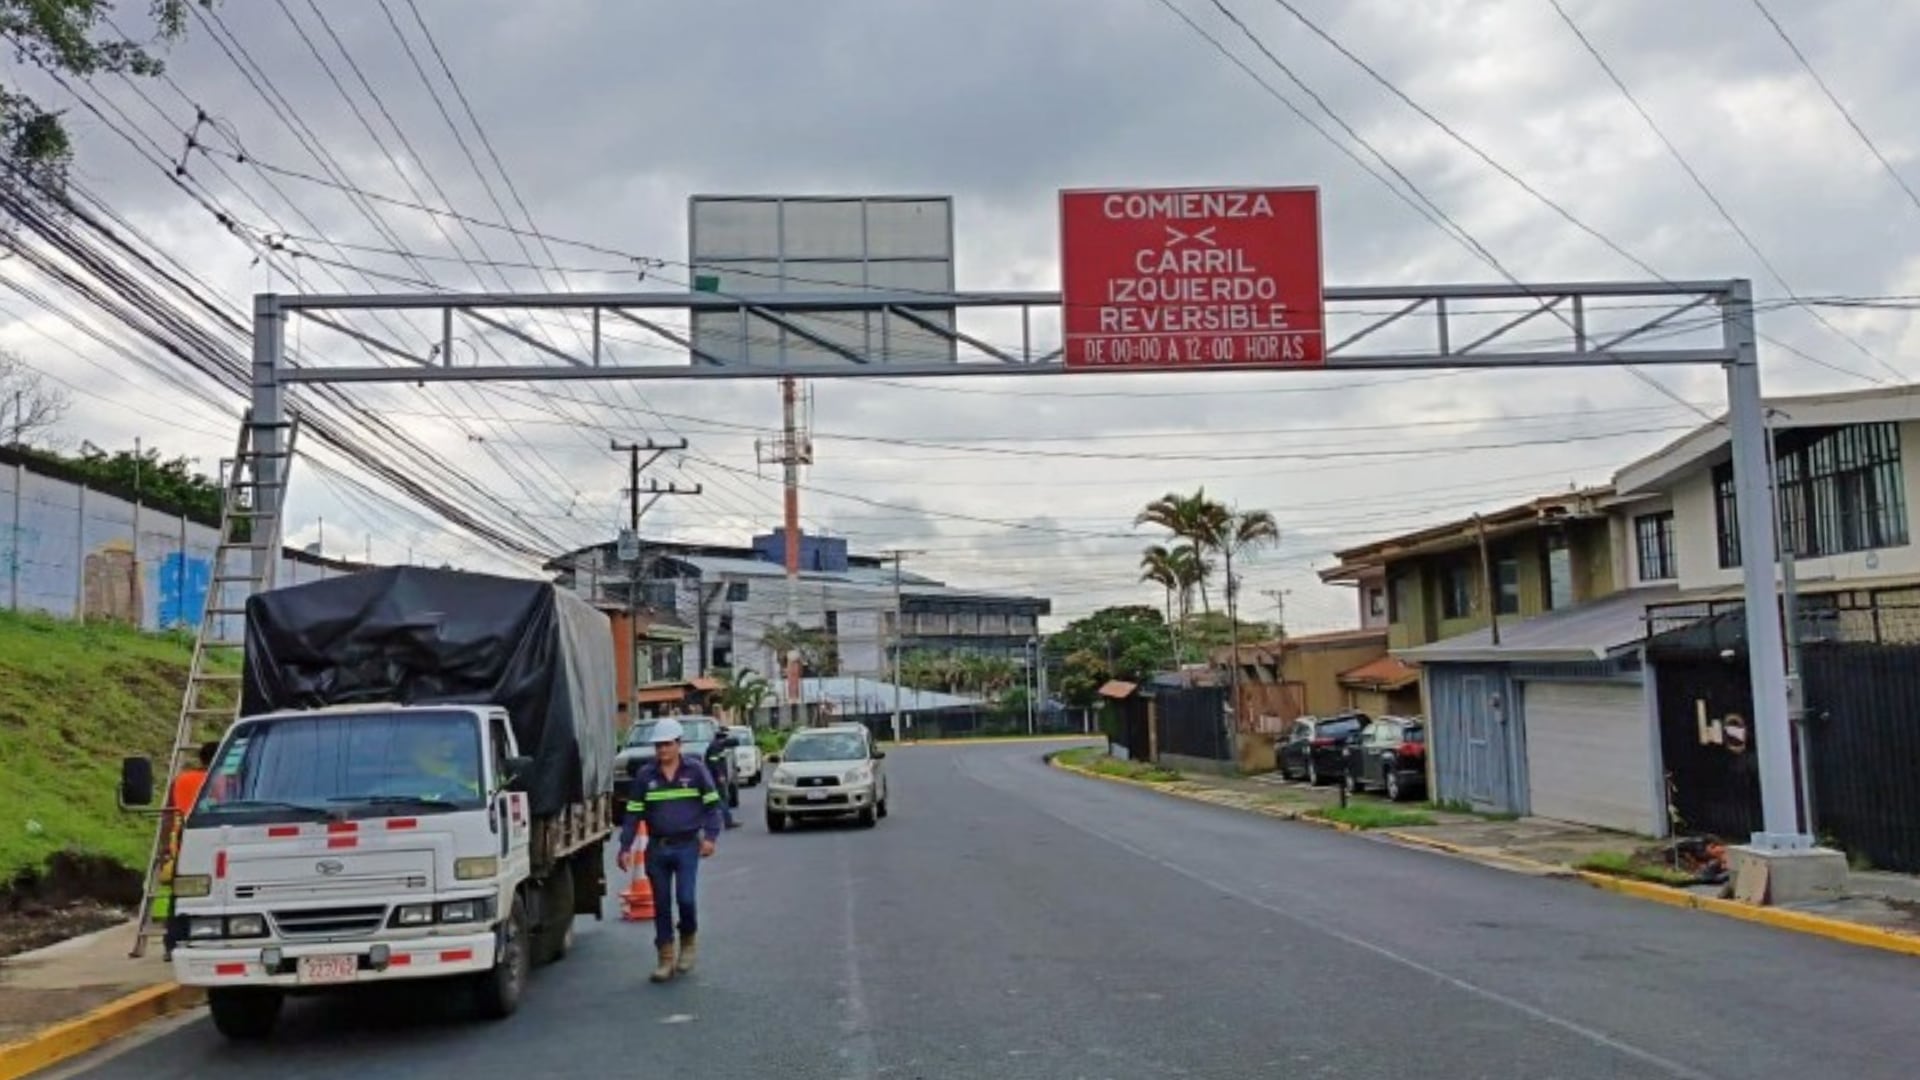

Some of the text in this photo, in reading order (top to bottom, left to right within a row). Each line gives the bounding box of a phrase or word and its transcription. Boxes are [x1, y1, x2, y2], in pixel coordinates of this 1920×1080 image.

[1104, 194, 1274, 218] COMIENZA
[1136, 249, 1256, 274] CARRIL
[1108, 277, 1277, 302] IZQUIERDO
[1100, 304, 1289, 331] REVERSIBLE
[1085, 335, 1304, 363] DE 00:00 A 12:00 HORAS
